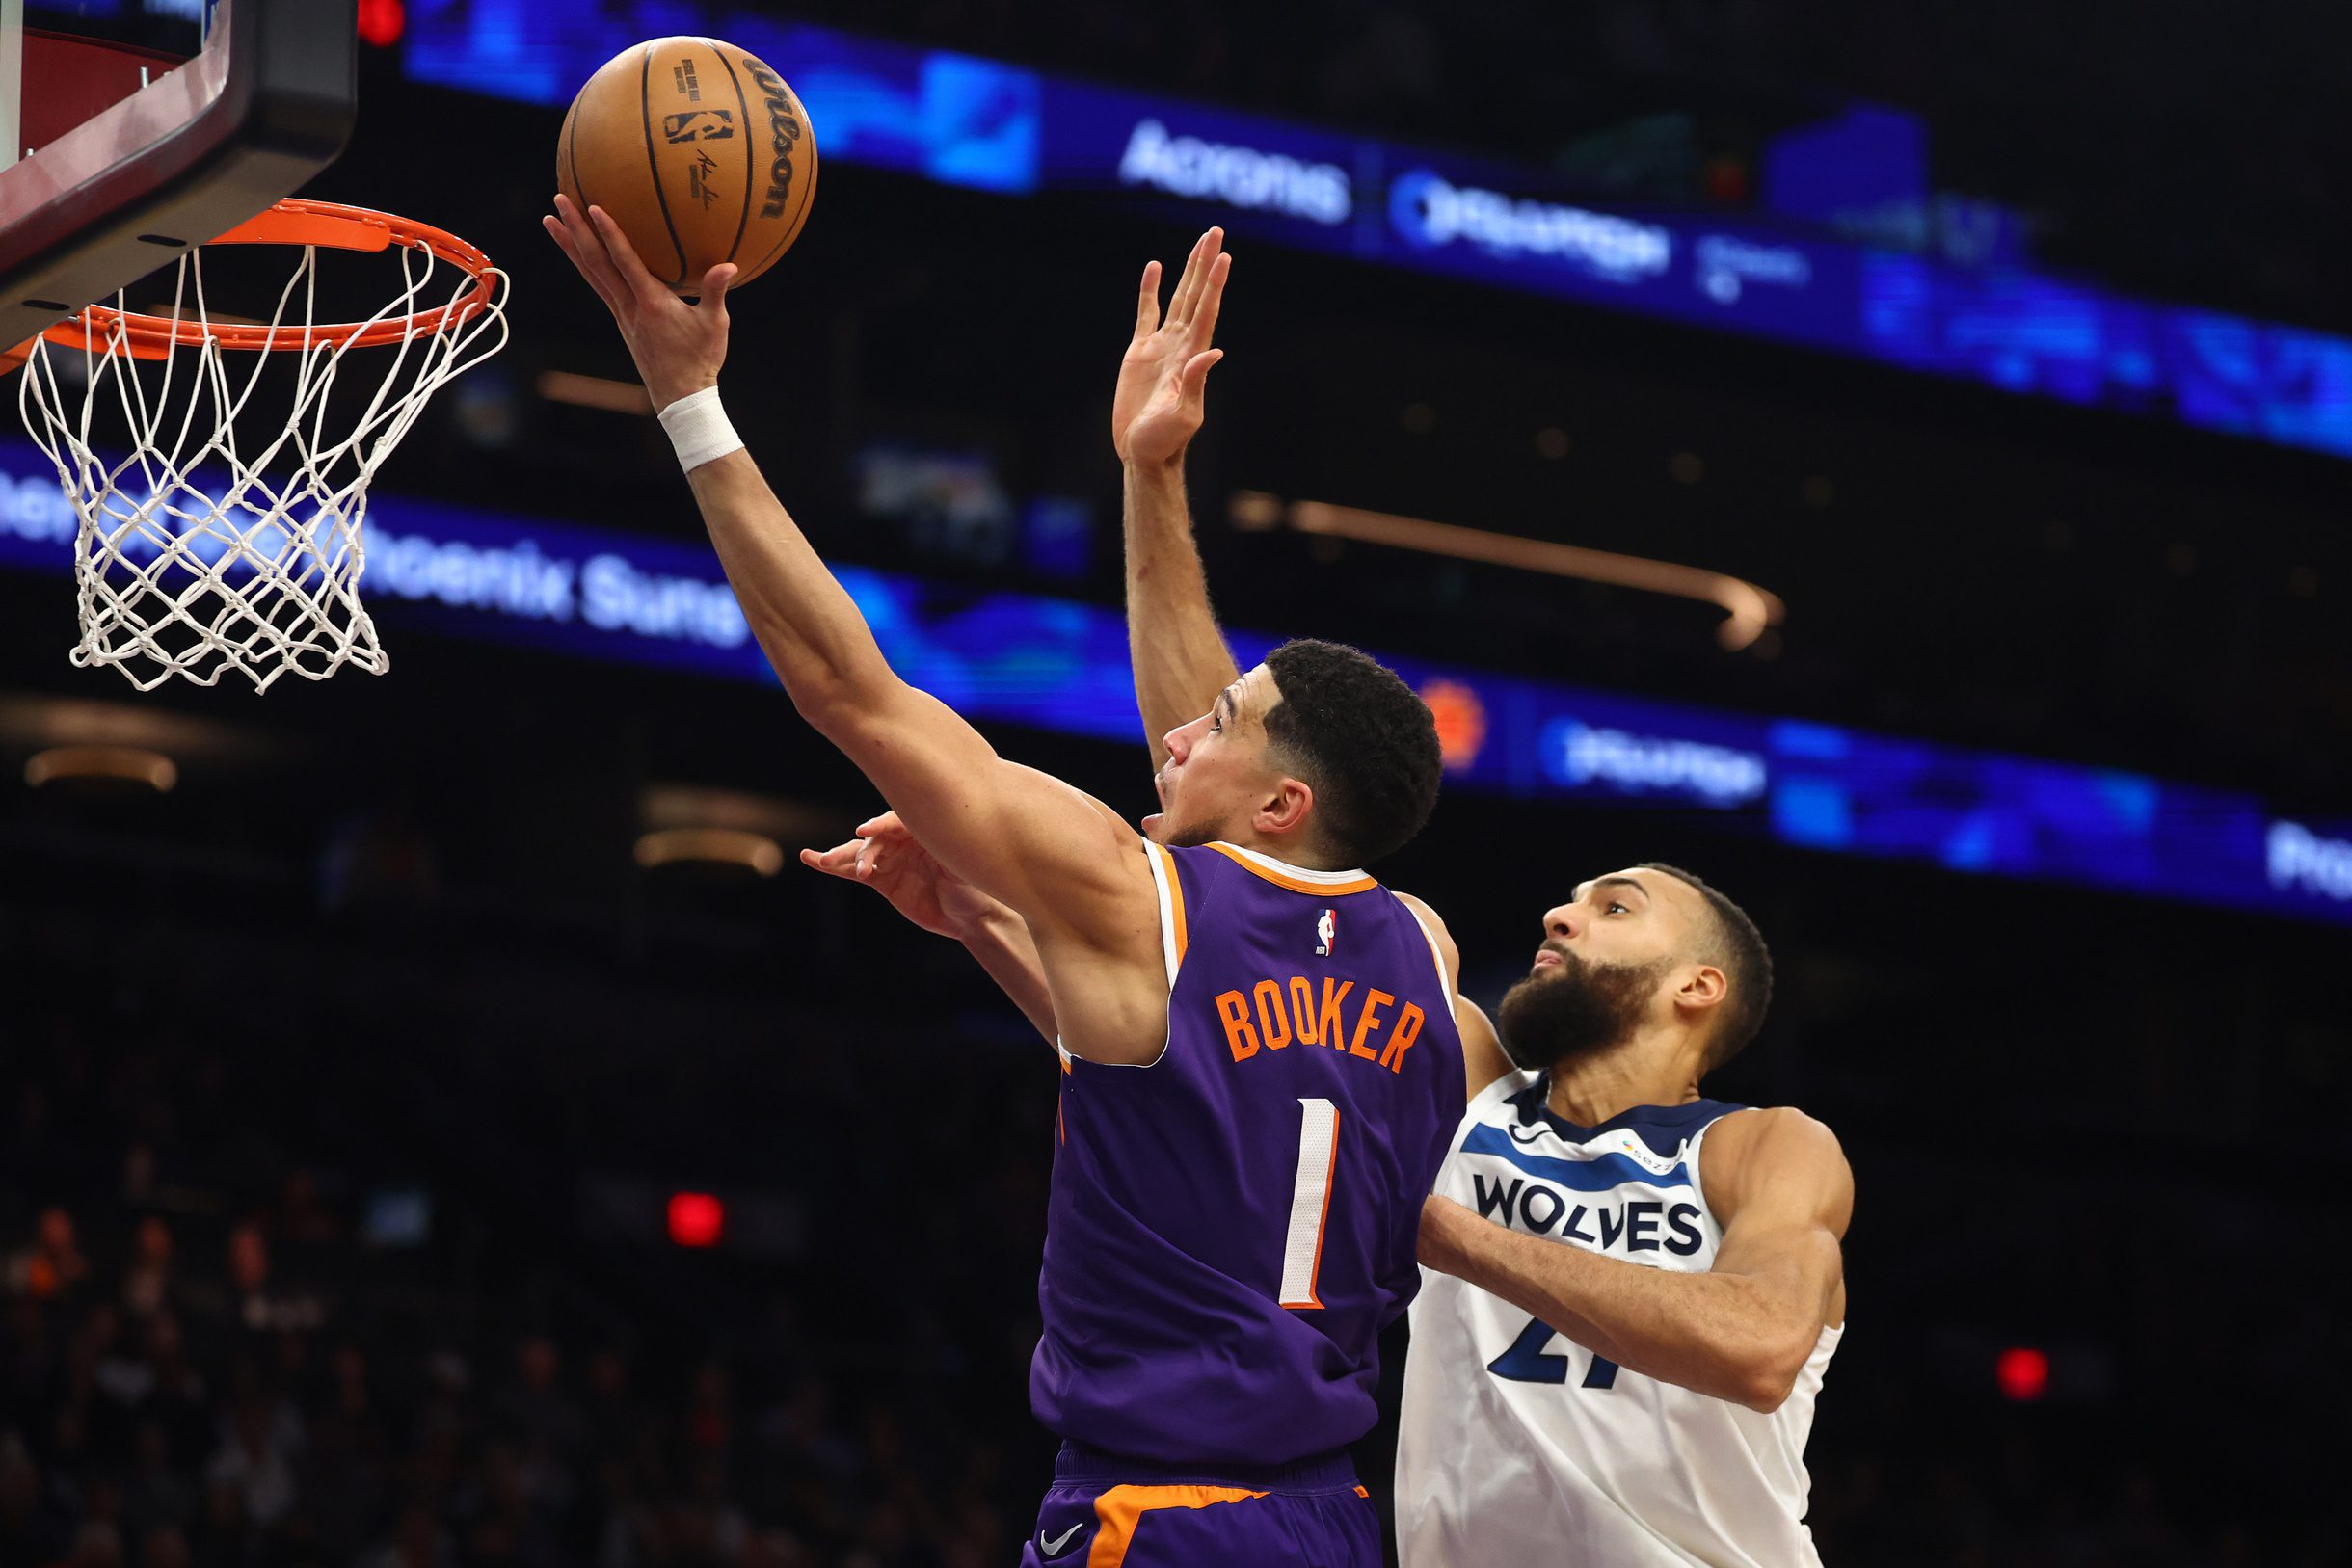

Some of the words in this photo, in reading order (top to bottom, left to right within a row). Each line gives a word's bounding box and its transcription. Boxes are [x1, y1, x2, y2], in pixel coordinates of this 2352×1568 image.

[743, 59, 801, 219] Wilson
[1215, 976, 1426, 1075] BOOKER
[1279, 1098, 1341, 1310] 1
[1473, 1173, 1704, 1257] WOLVES
